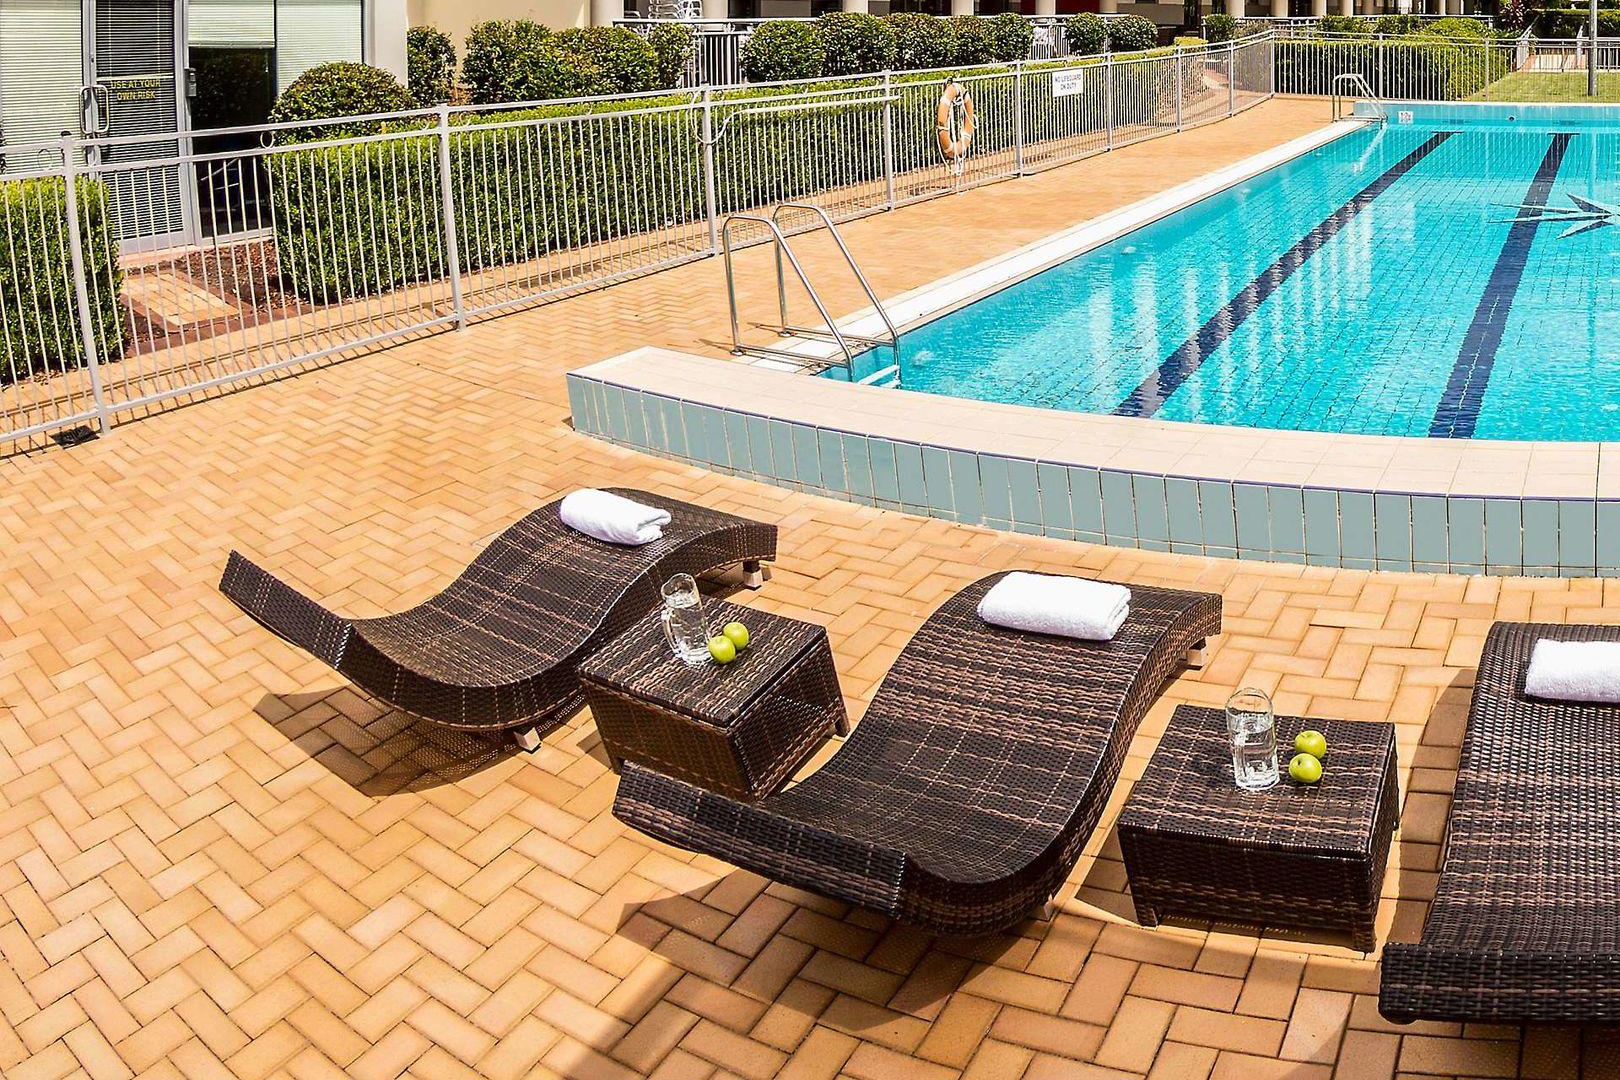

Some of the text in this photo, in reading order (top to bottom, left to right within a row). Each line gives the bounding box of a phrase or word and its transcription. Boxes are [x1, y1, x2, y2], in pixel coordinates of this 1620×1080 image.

[111, 81, 128, 89] USE
[140, 79, 161, 88] YOUR
[117, 90, 156, 101] OWN RISK
